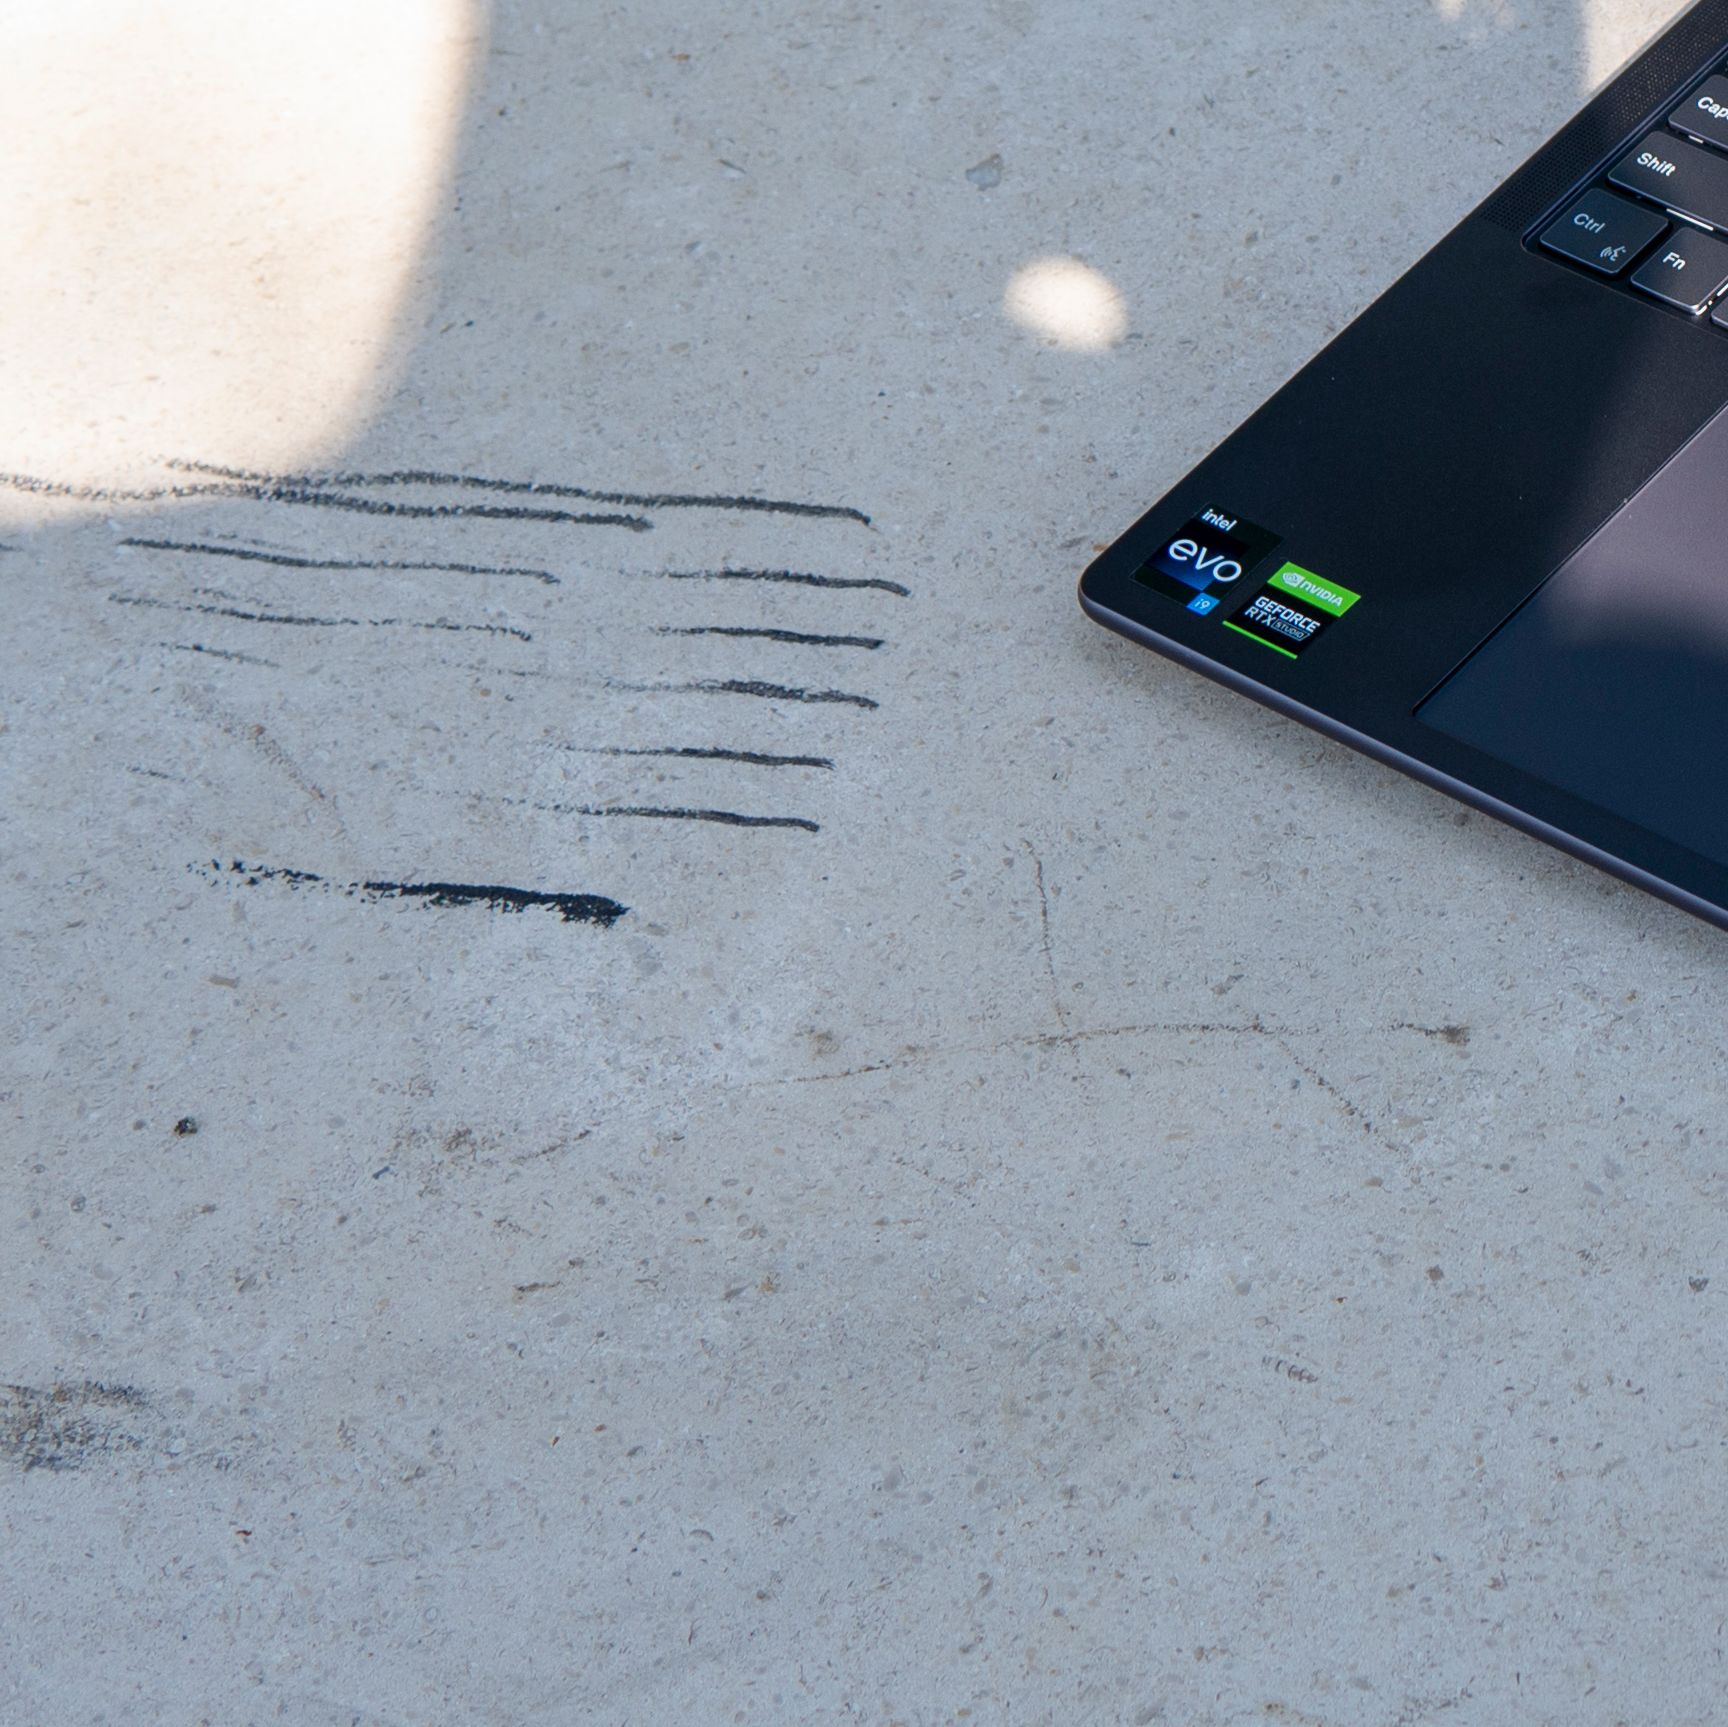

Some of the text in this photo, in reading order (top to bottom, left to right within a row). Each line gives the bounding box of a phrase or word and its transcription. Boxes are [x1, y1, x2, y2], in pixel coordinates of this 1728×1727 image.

[1636, 152, 1676, 177] Shift
[1573, 212, 1606, 234] Ctrl
[1662, 251, 1686, 271] Fn
[1202, 509, 1237, 532] intel
[1169, 538, 1243, 583] evo
[1194, 598, 1211, 609] i9
[1300, 582, 1343, 607] NVIDIA
[1245, 606, 1304, 639] RTX STUDIO
[1255, 596, 1321, 632] GEFORCE
